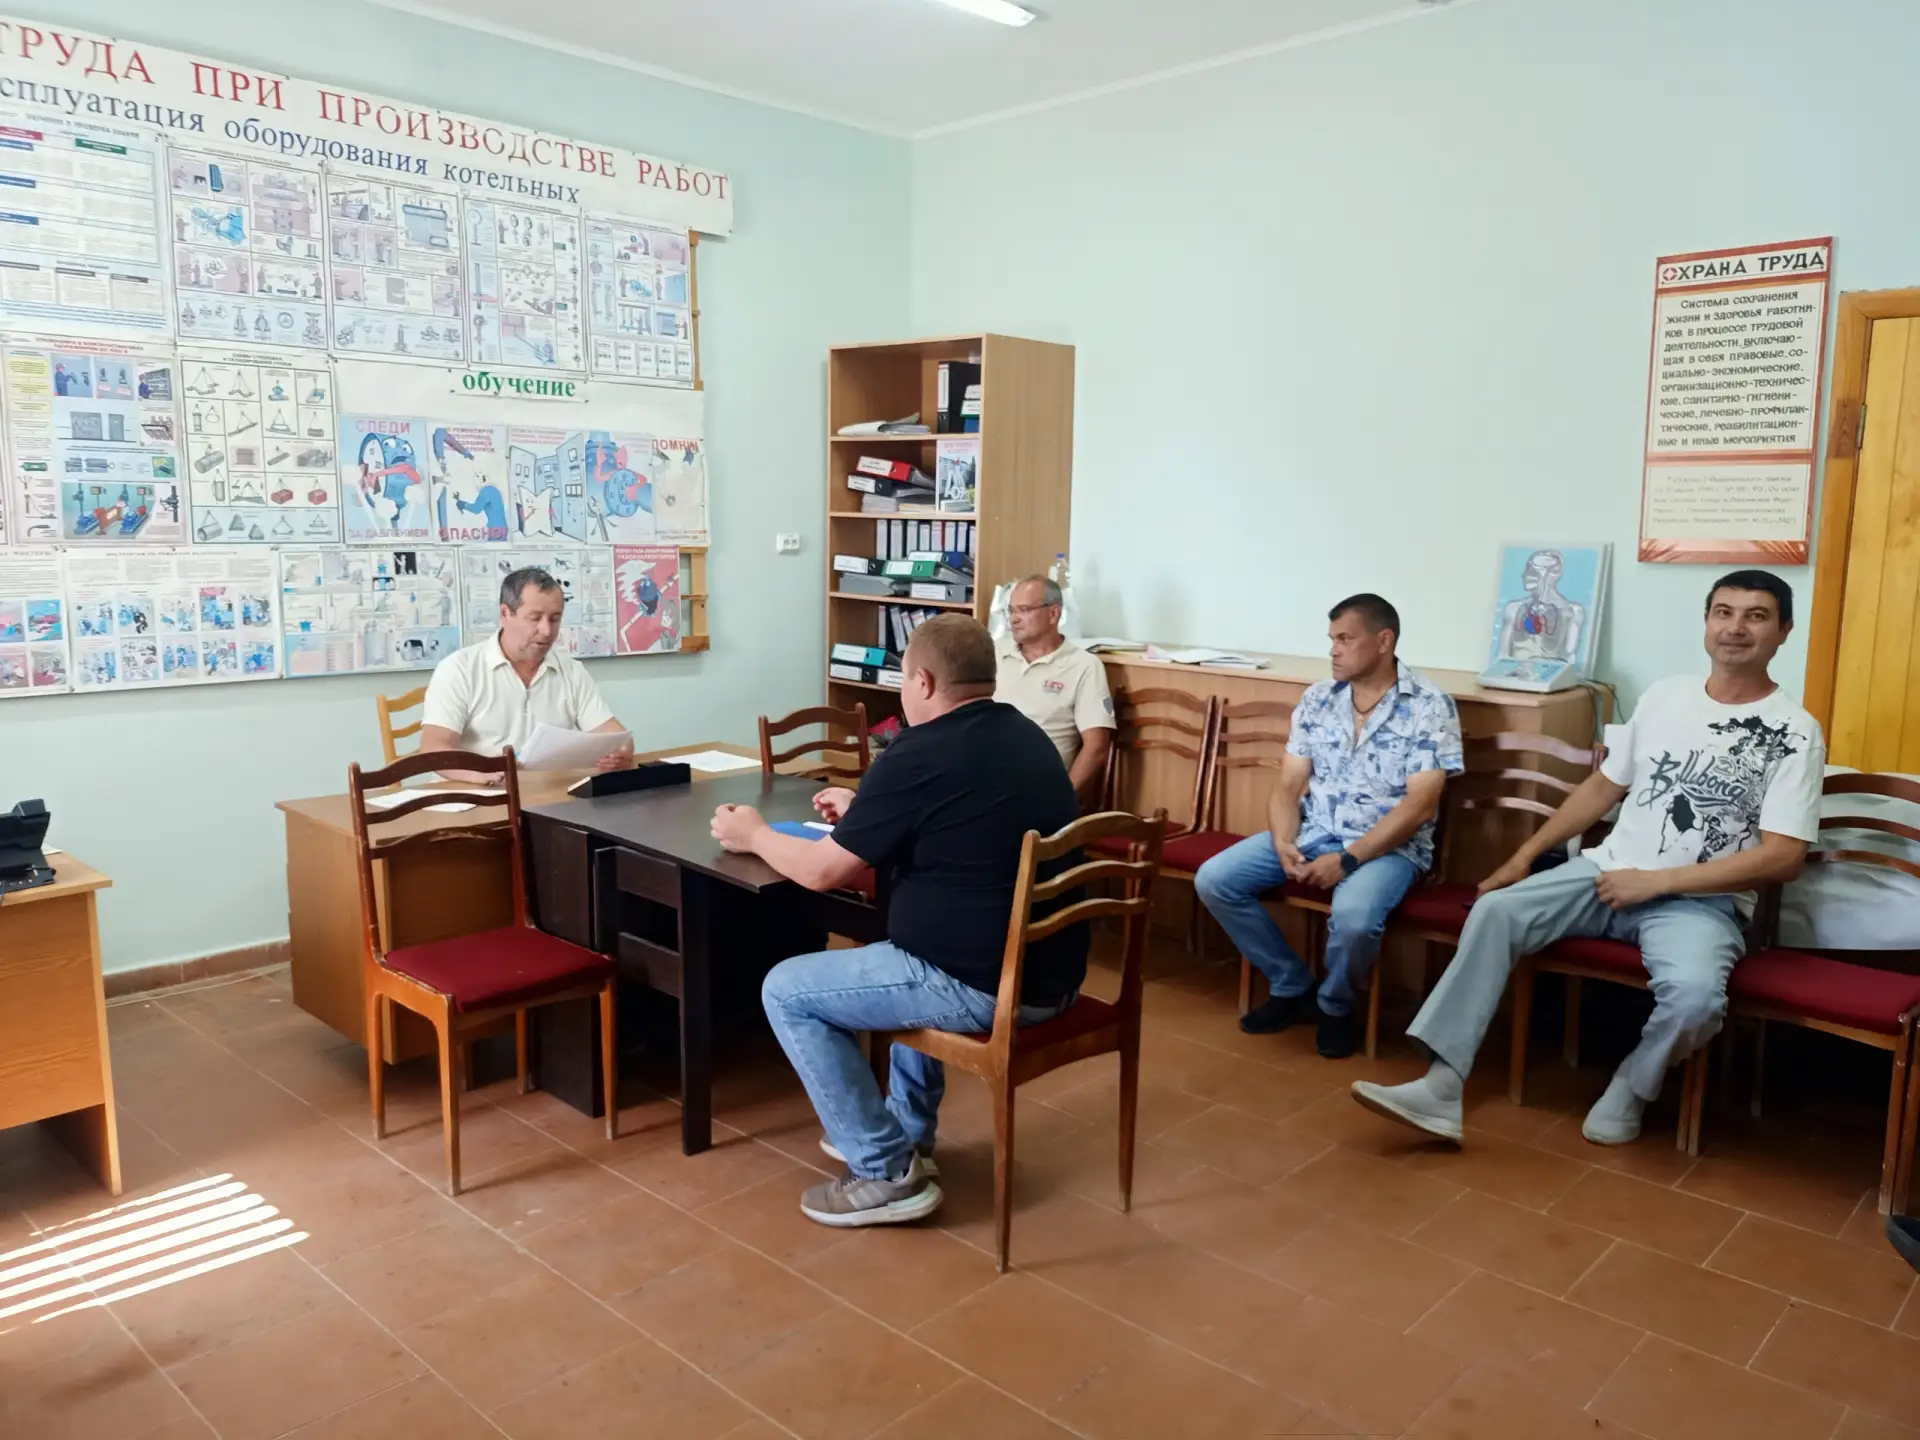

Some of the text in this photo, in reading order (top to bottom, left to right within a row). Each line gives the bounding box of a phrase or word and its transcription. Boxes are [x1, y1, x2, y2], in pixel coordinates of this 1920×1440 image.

[190, 61, 286, 112] ПРИ
[317, 89, 617, 178] ПРОИЗВОДСТВЕ
[637, 159, 730, 200] РАБОТ
[224, 118, 429, 176] оборудования
[443, 162, 581, 204] котельных
[1662, 251, 1825, 282] ОХРАНА ТРУДА
[1680, 291, 1798, 310] Система сохранения
[462, 371, 577, 398] обучение
[355, 419, 410, 434] СЛЕДИ
